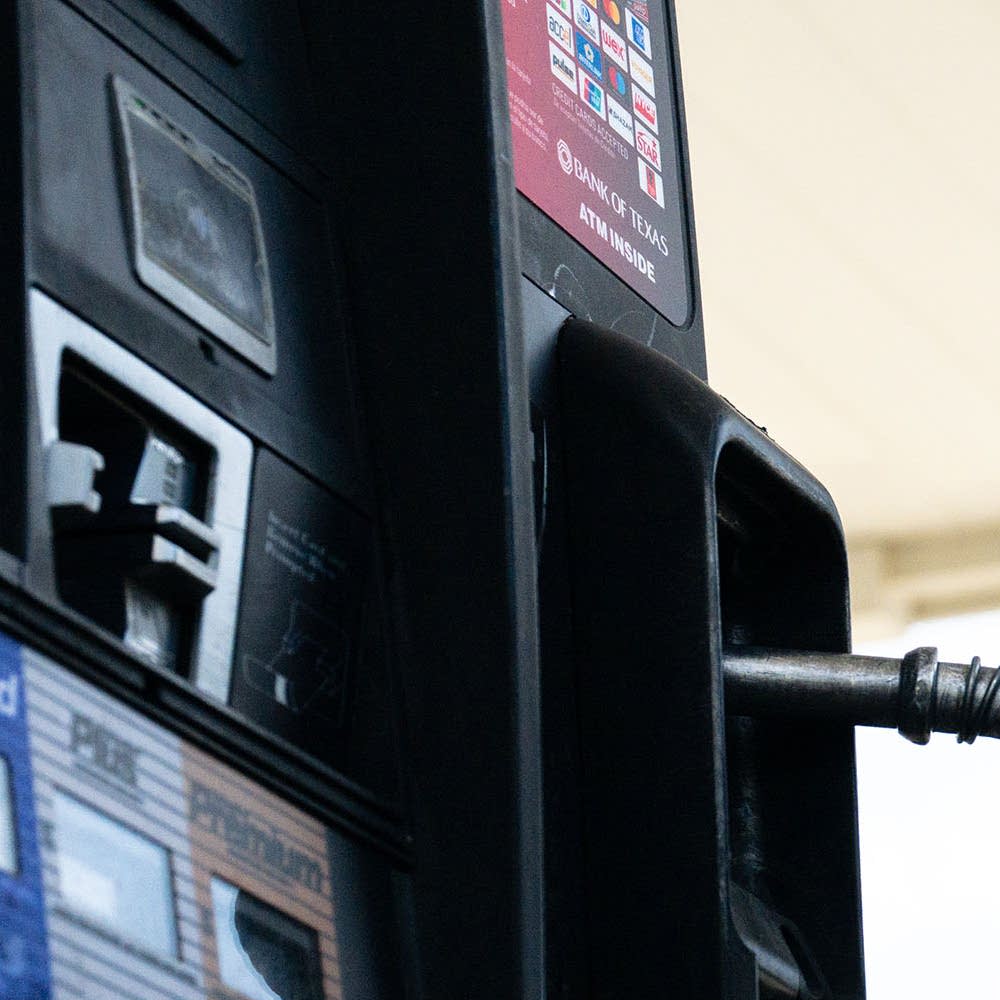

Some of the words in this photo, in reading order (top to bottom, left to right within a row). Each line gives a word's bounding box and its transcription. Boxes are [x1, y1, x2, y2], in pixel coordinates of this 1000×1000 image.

[597, 124, 629, 160] ACCEPTED
[637, 136, 659, 166] STAR
[573, 157, 611, 205] BANK
[611, 191, 627, 218] OF
[629, 206, 669, 256] TEXAS
[579, 202, 609, 241] ATM
[609, 228, 656, 283] INSIDE
